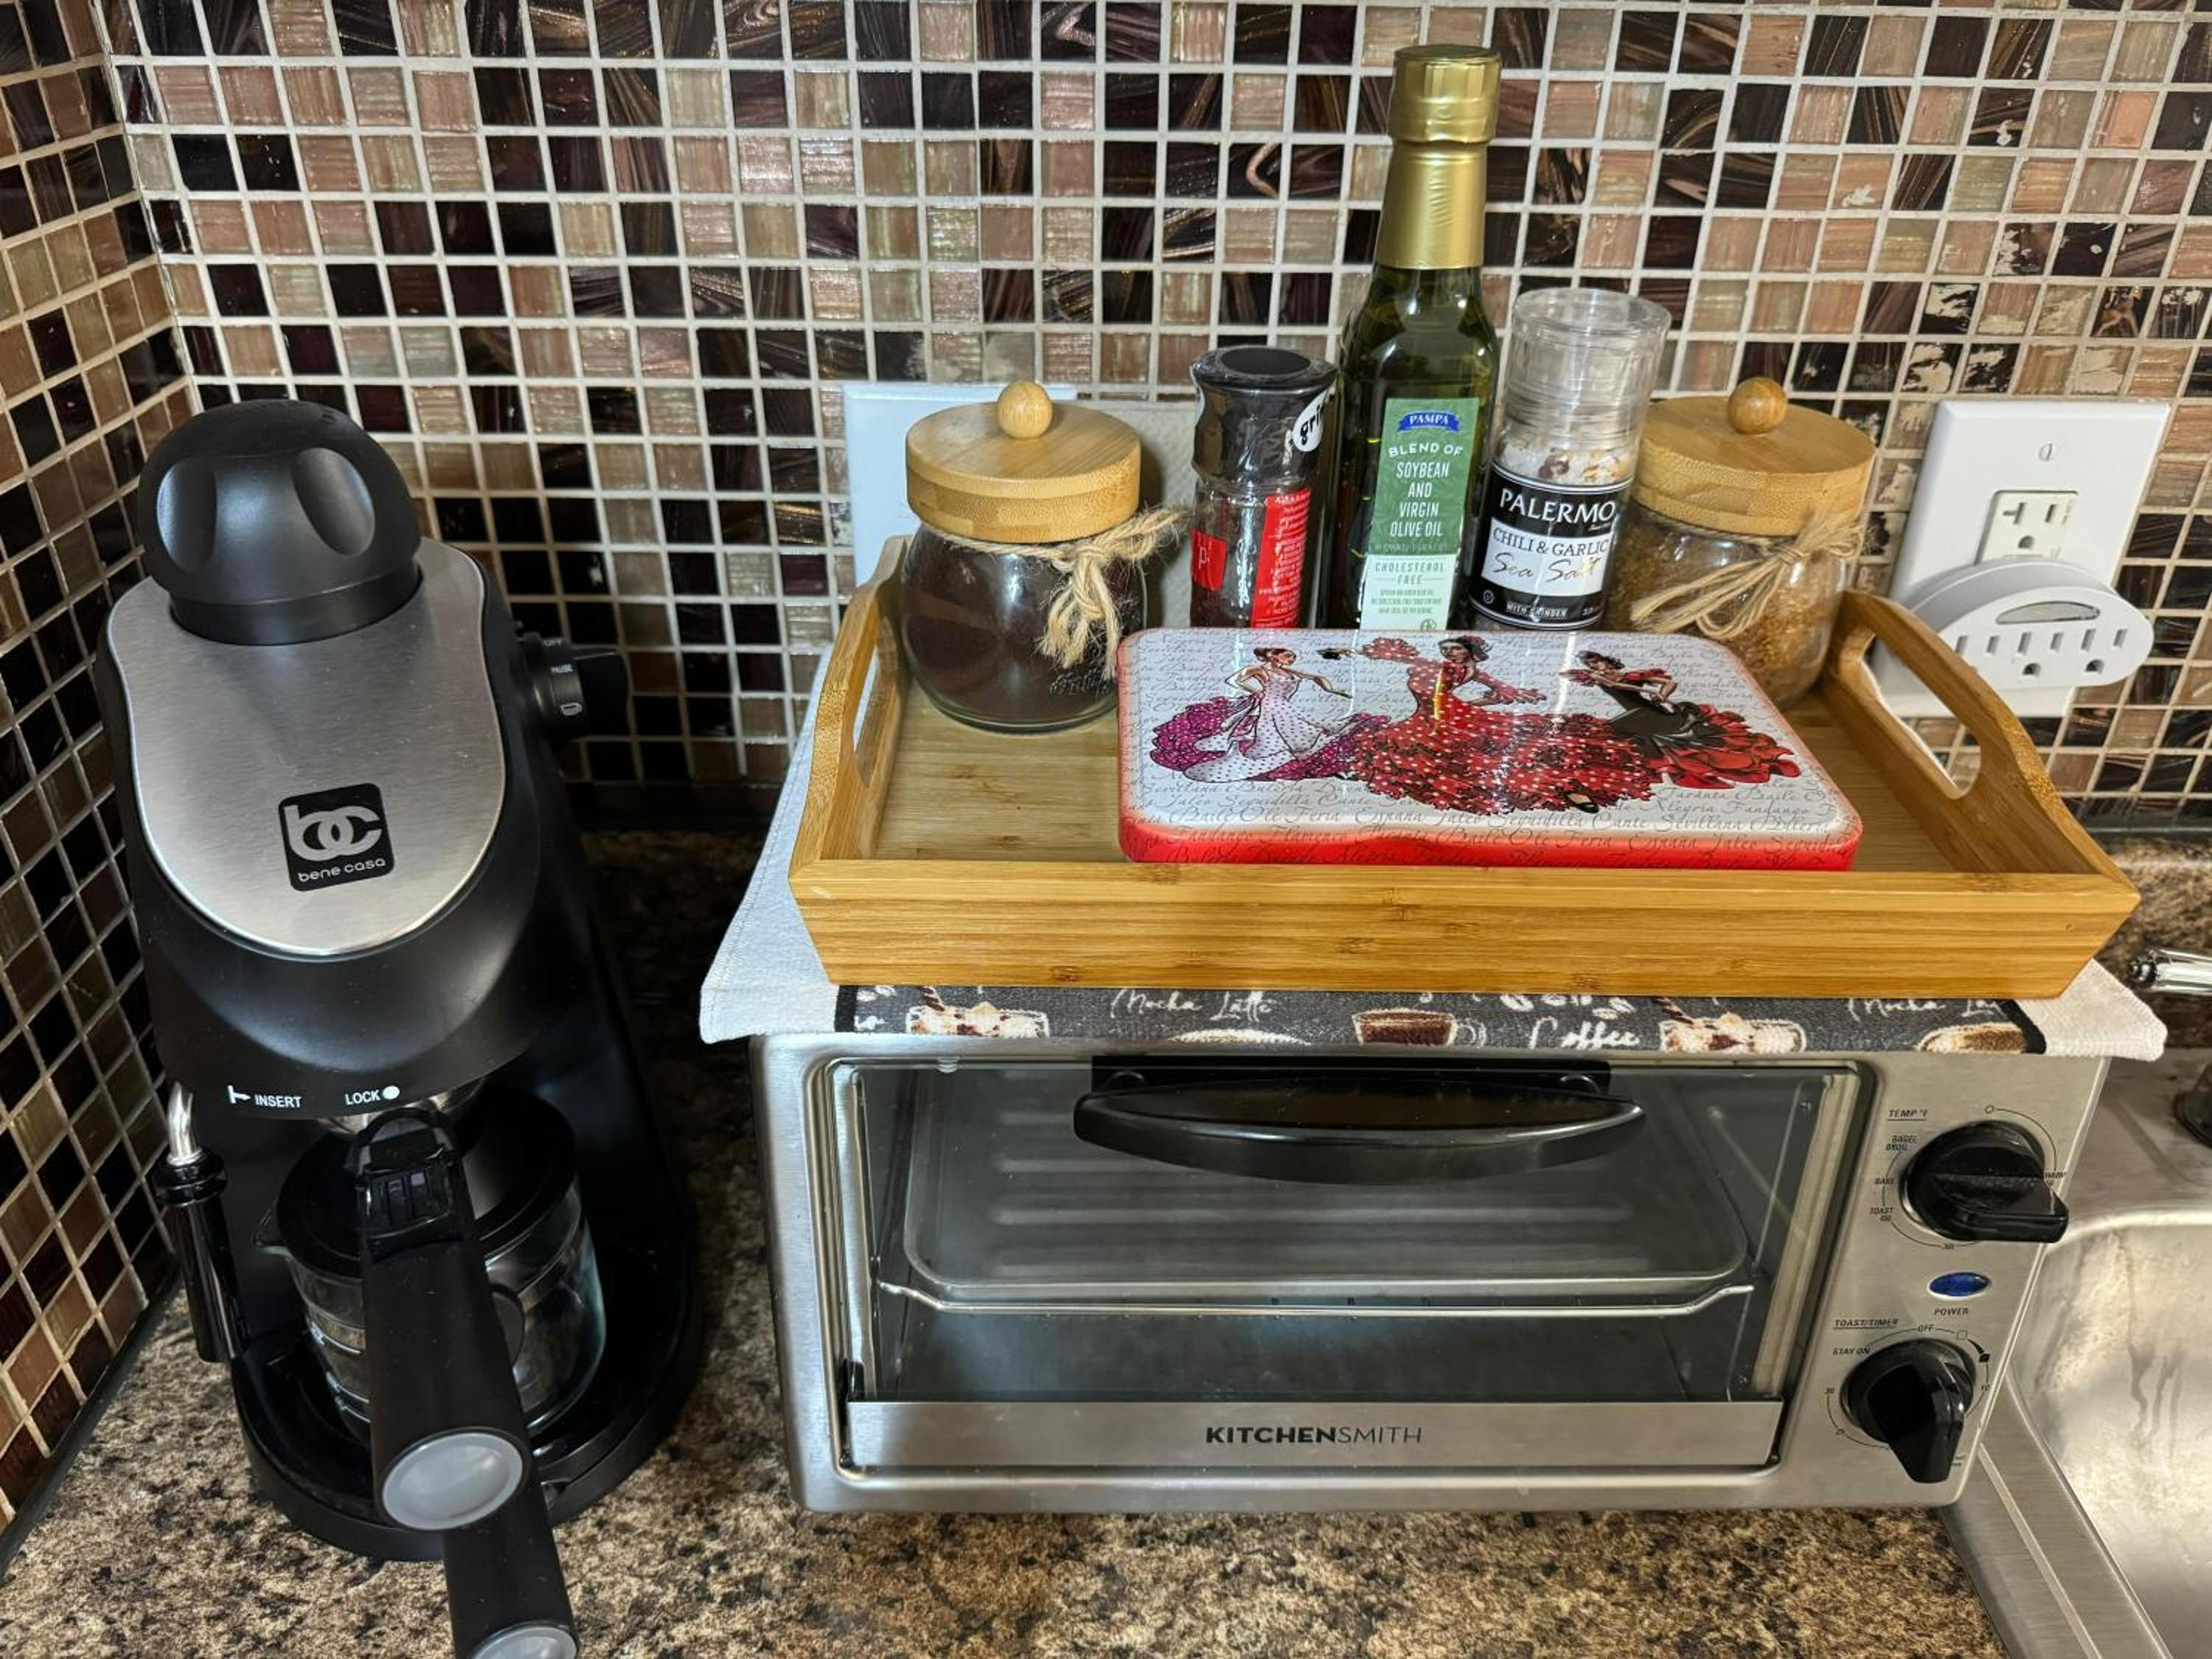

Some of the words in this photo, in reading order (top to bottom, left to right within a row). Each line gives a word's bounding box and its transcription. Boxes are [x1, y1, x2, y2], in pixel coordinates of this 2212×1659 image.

[1408, 414, 1450, 427] PAMPA
[1388, 442, 1439, 458] BLEND
[1443, 445, 1464, 457] OF
[1396, 462, 1450, 479] SOYBEAN
[1408, 482, 1433, 498] AND
[1399, 501, 1440, 518] VIRGIN
[1500, 488, 1616, 524] PALERMO
[1390, 521, 1424, 538] OLIVE
[1425, 521, 1444, 538] OIL
[1492, 527, 1534, 553] CHILI
[1536, 540, 1550, 555] &
[1552, 539, 1610, 557] GARLIC
[1374, 561, 1445, 574] CHOLESTEROL
[1492, 552, 1534, 578] Sea
[297, 866, 341, 883] bene
[344, 858, 386, 872] casa
[254, 1093, 303, 1108] INSERT
[344, 1089, 381, 1106] LOCK
[1888, 1108, 1917, 1118] TEMP
[1933, 1307, 1970, 1317] POWER
[1834, 1318, 1899, 1328] TOAST/TIMER
[1917, 1324, 1935, 1333] OFF
[1832, 1346, 1854, 1356] STAY
[1856, 1346, 1871, 1356] ON
[1206, 1426, 1422, 1444] KITCHENSMITH
